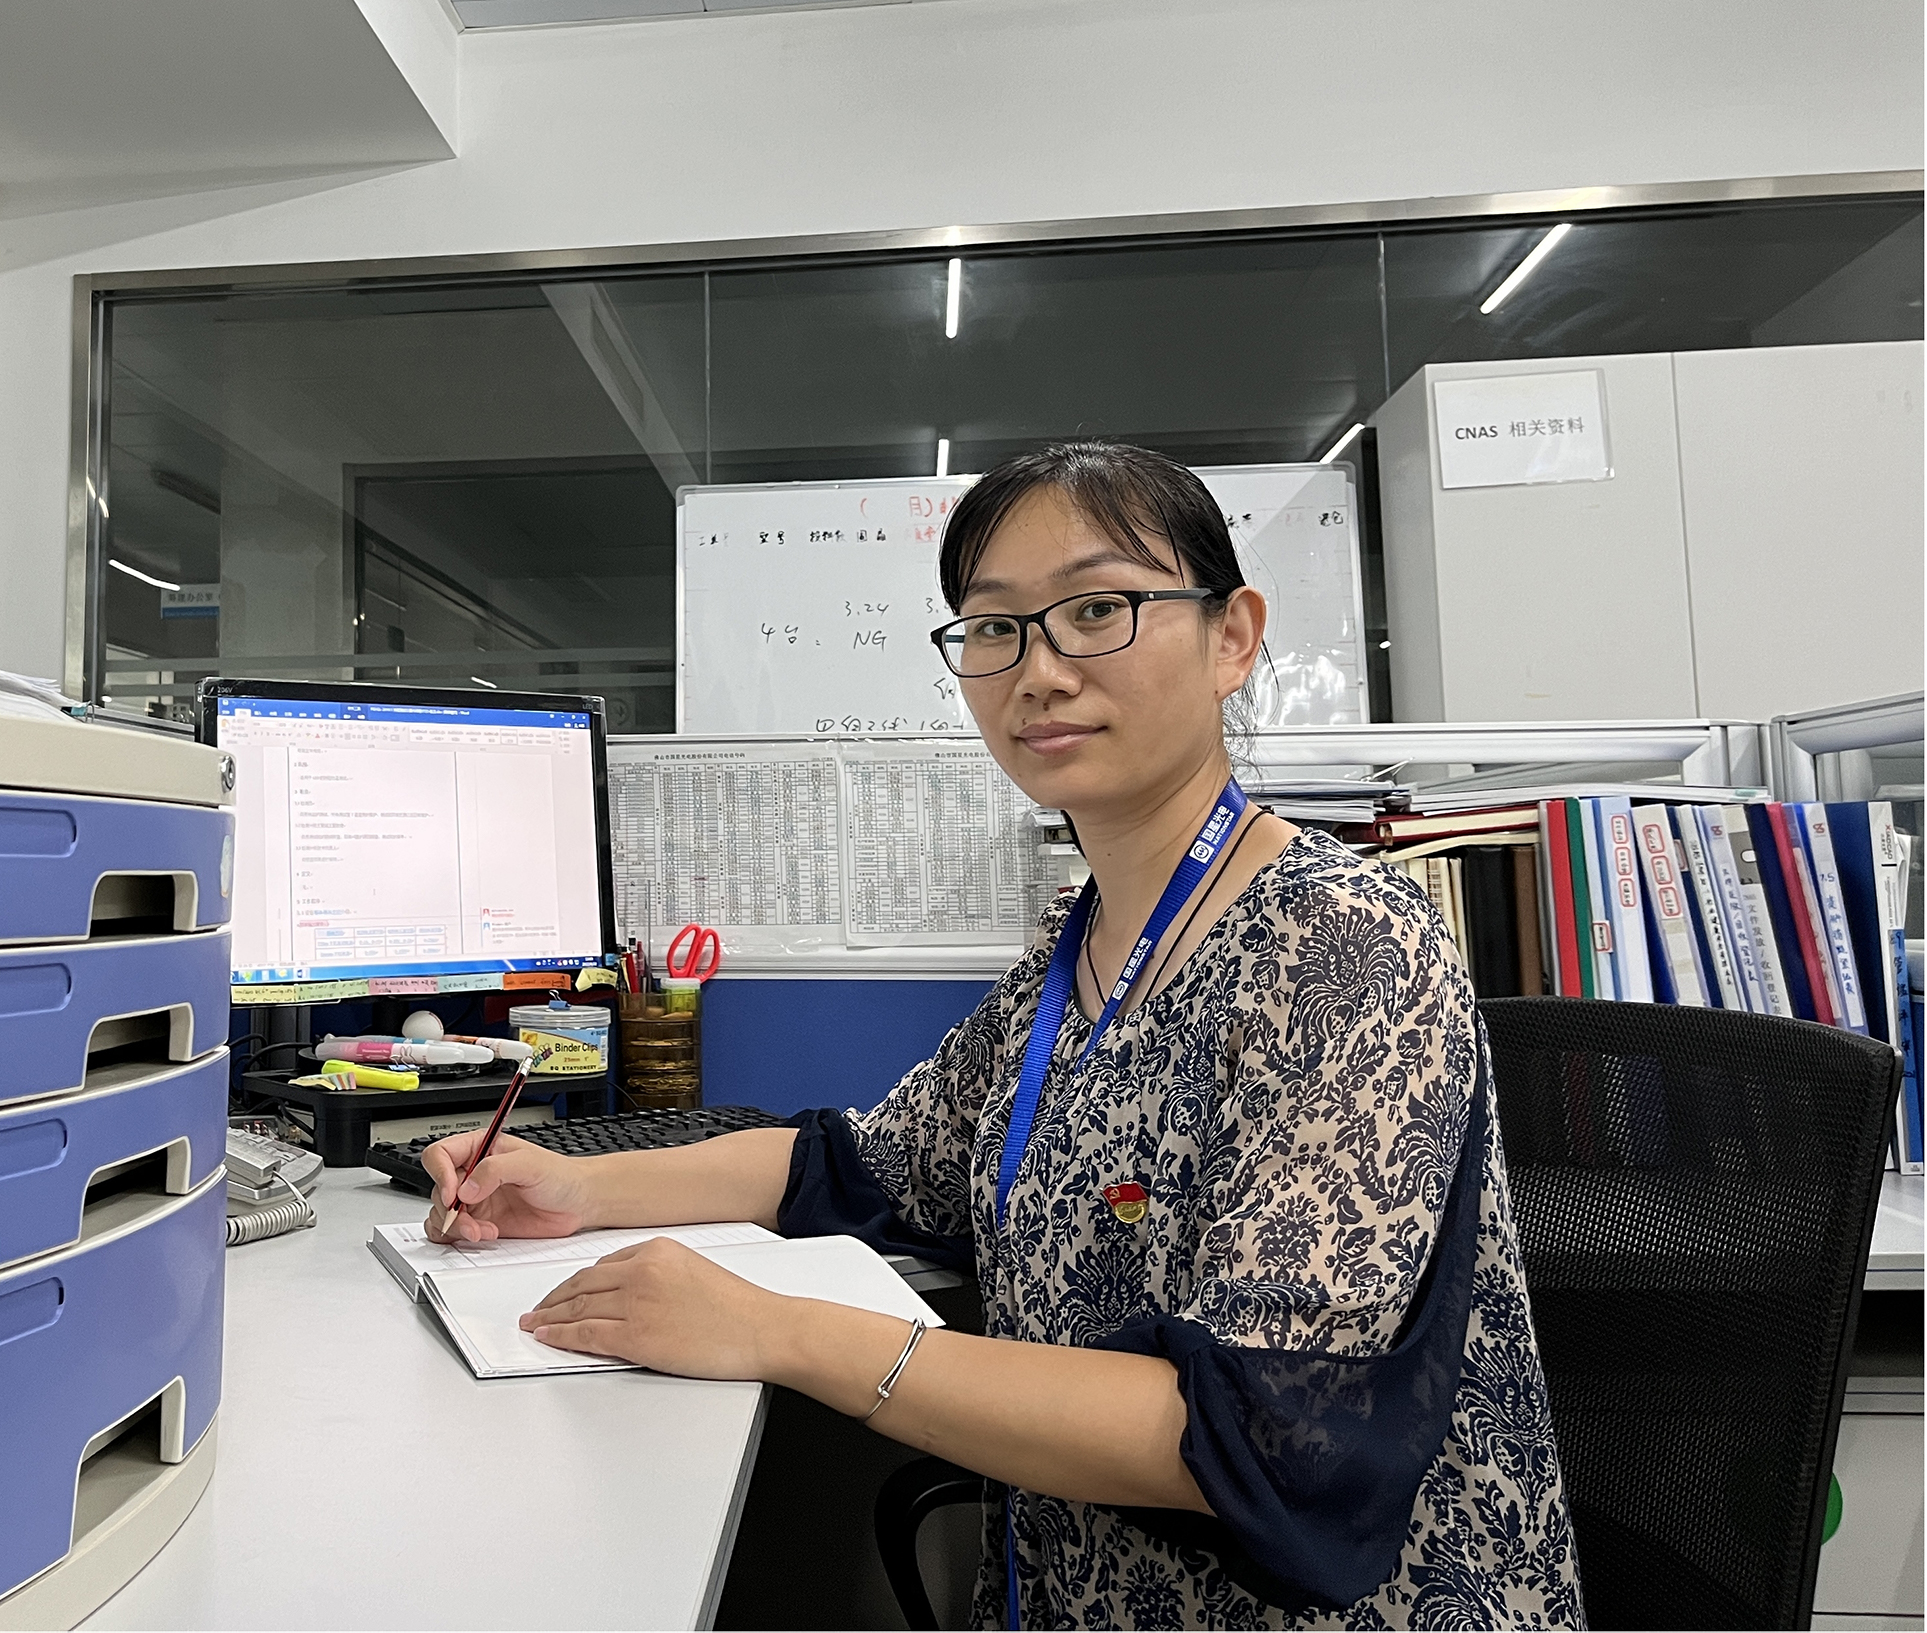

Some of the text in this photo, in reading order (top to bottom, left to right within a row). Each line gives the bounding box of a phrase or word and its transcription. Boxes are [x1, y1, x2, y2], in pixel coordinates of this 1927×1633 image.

[1454, 416, 1586, 441] CNAS 相关资料
[853, 631, 888, 650] NG
[1201, 805, 1230, 842] 国星光电
[1212, 811, 1235, 846] NATIONSTAR
[1122, 936, 1149, 979] 国星光电
[554, 1042, 599, 1053] Binder Clips
